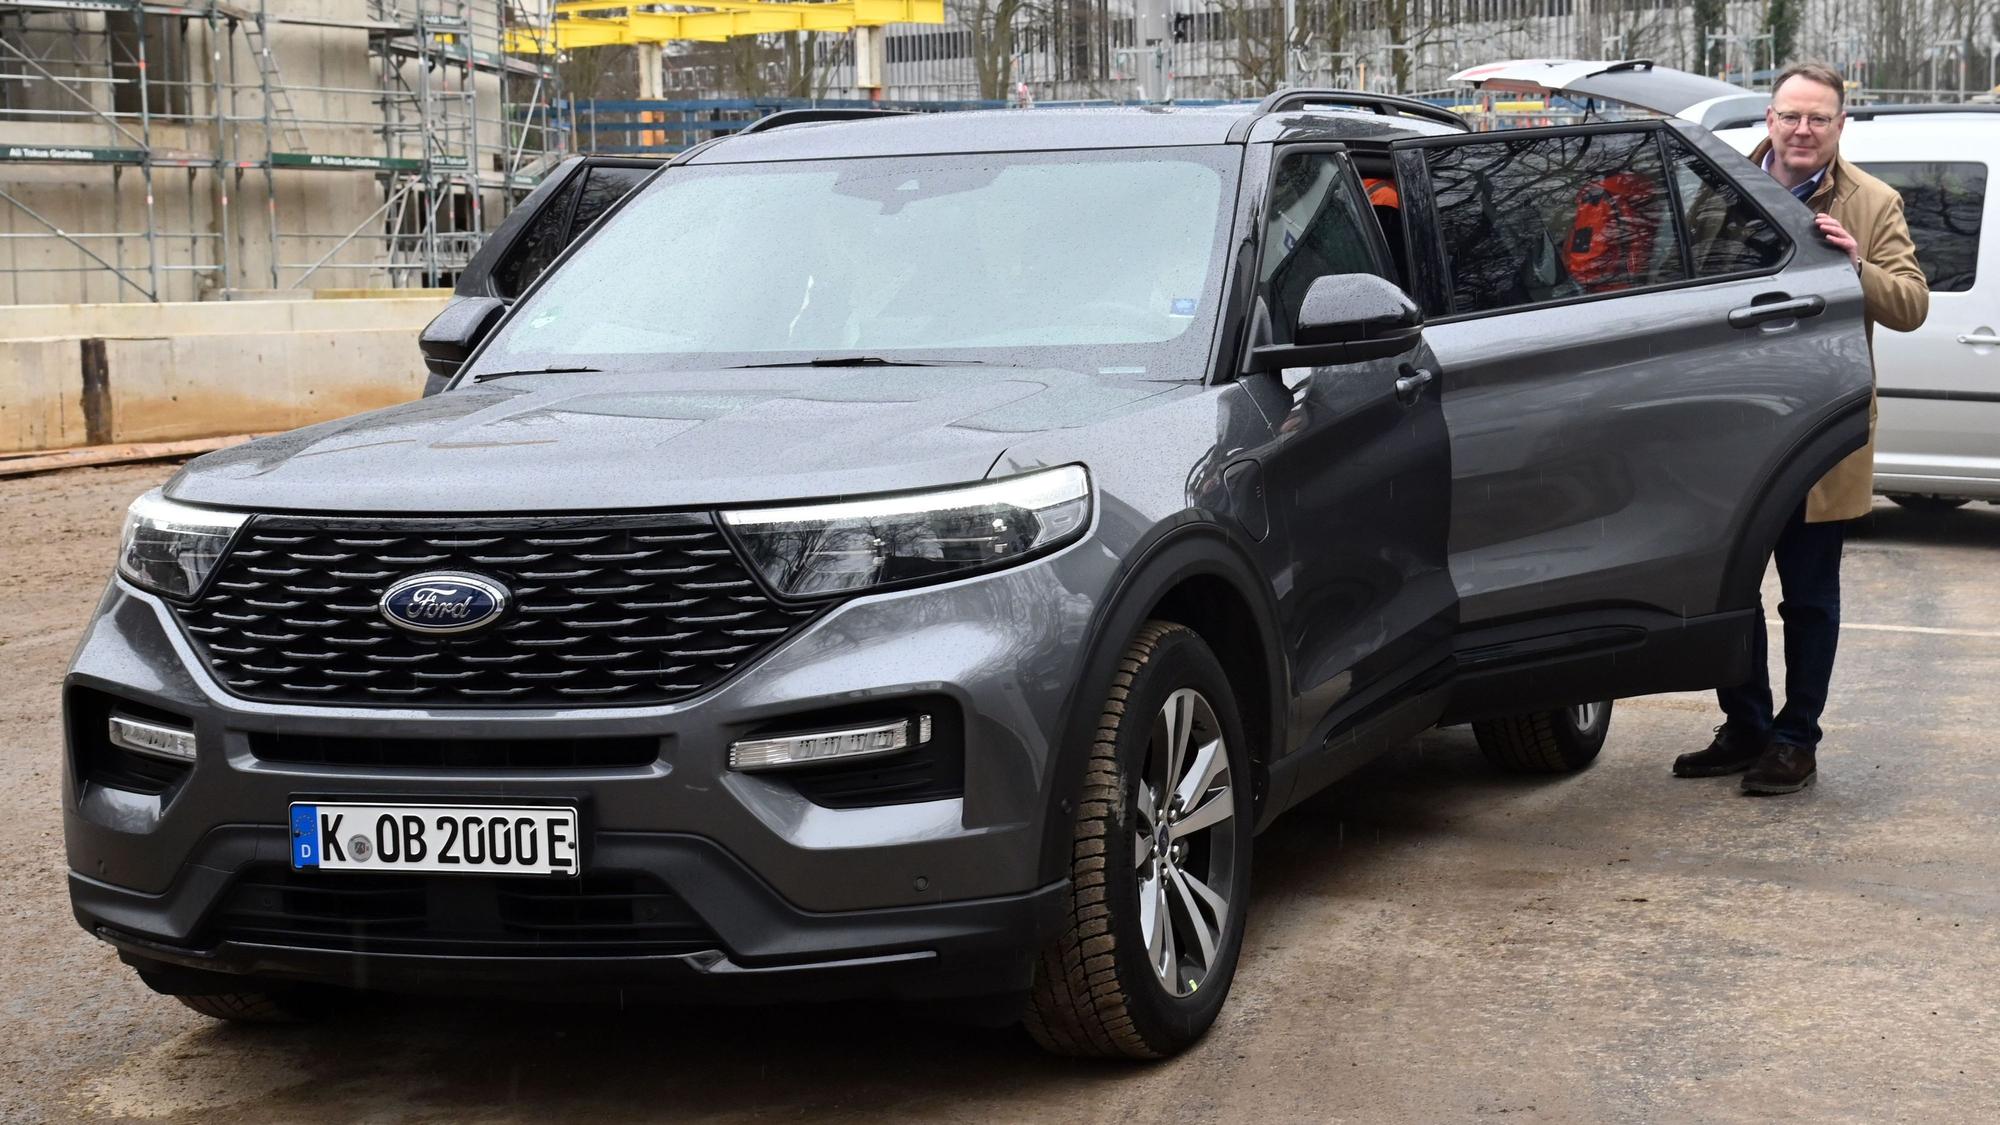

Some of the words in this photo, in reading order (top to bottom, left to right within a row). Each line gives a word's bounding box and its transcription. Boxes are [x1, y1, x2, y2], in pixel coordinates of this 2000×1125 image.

[406, 587, 473, 619] Ford
[301, 844, 312, 858] D
[321, 813, 347, 862] K
[376, 813, 428, 863] OB
